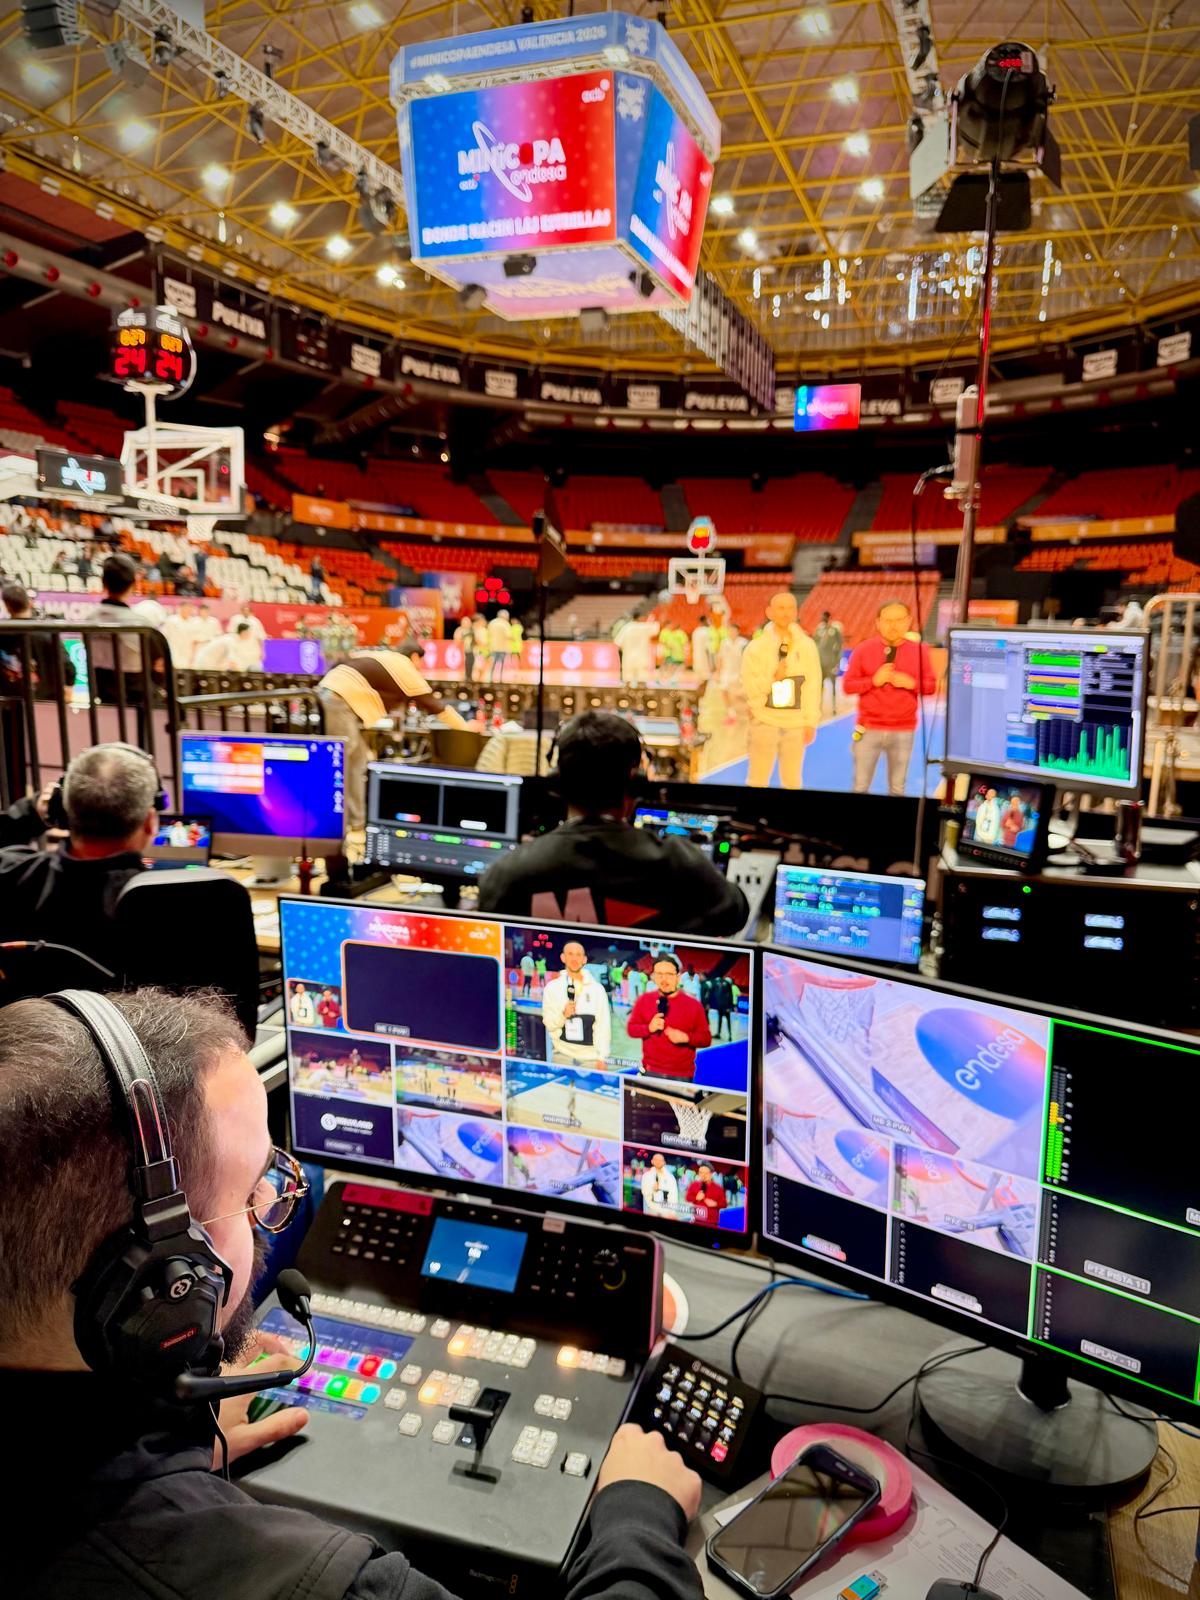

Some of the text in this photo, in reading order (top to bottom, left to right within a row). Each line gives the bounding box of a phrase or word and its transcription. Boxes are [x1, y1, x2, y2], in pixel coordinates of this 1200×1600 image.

[115, 347, 147, 375] 24
[156, 349, 183, 380] 24
[541, 382, 602, 405] PULEVA
[685, 391, 749, 412] PULEVA
[955, 1028, 1025, 1090] endesa
[1084, 1343, 1118, 1361] REPLAY
